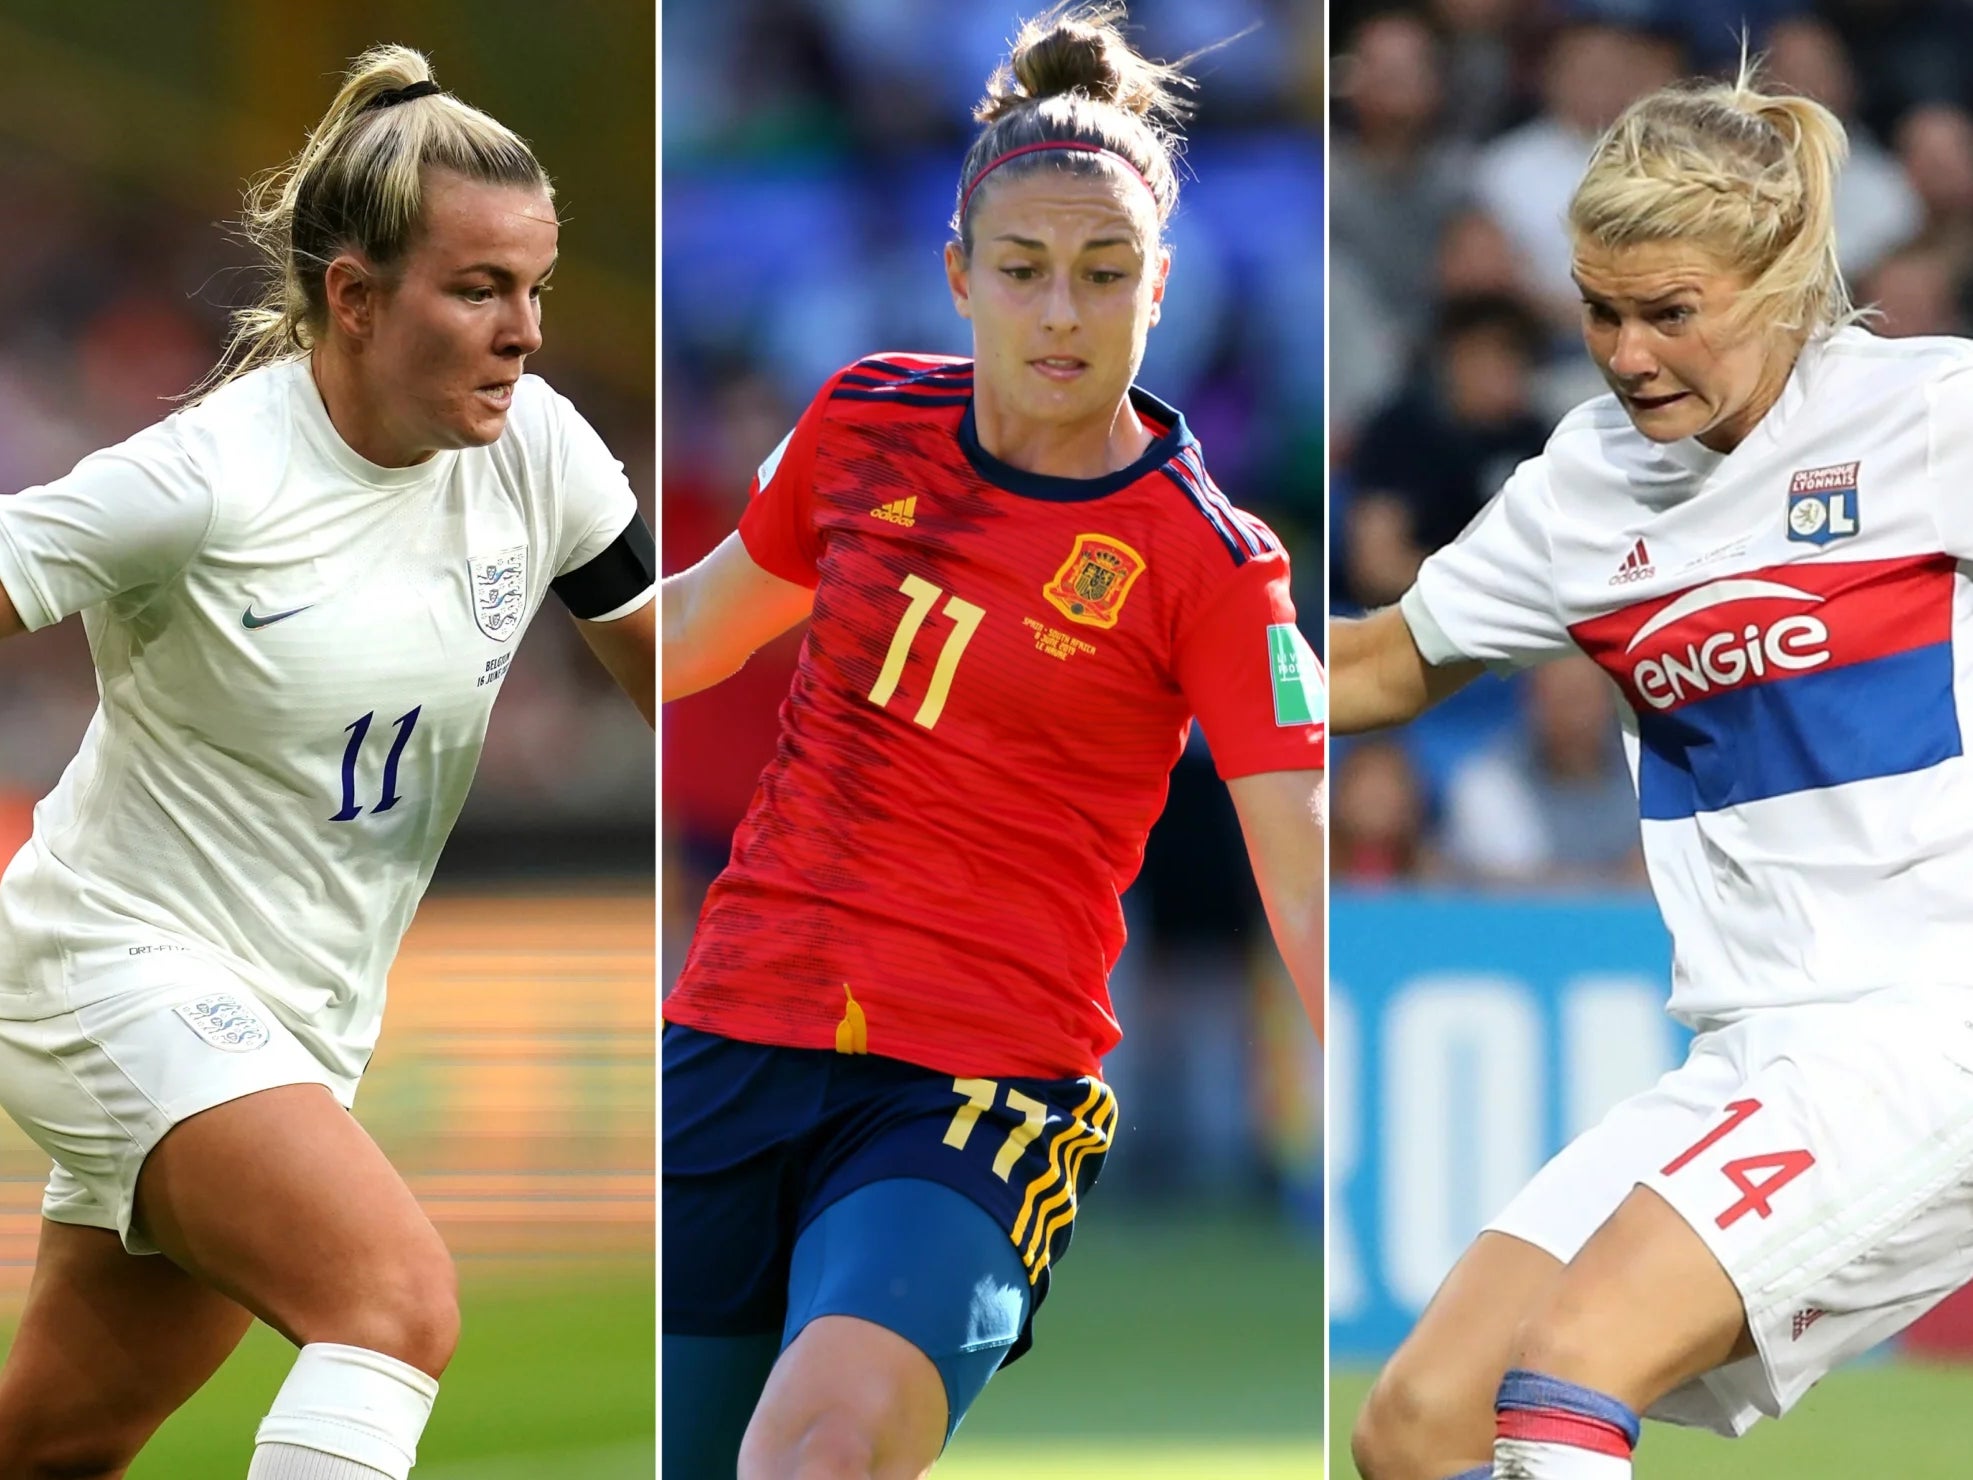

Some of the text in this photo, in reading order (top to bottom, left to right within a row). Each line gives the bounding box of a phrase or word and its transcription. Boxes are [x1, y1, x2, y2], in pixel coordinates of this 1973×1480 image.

[1792, 474, 1855, 492] LYONNAIS
[1795, 463, 1857, 481] OLYMPIQUE
[870, 506, 915, 527] adidas
[1608, 566, 1656, 586] adidas
[867, 573, 987, 730] 11
[328, 704, 422, 821] 11
[942, 1077, 1048, 1184] 11
[1660, 1098, 1816, 1231] 14
